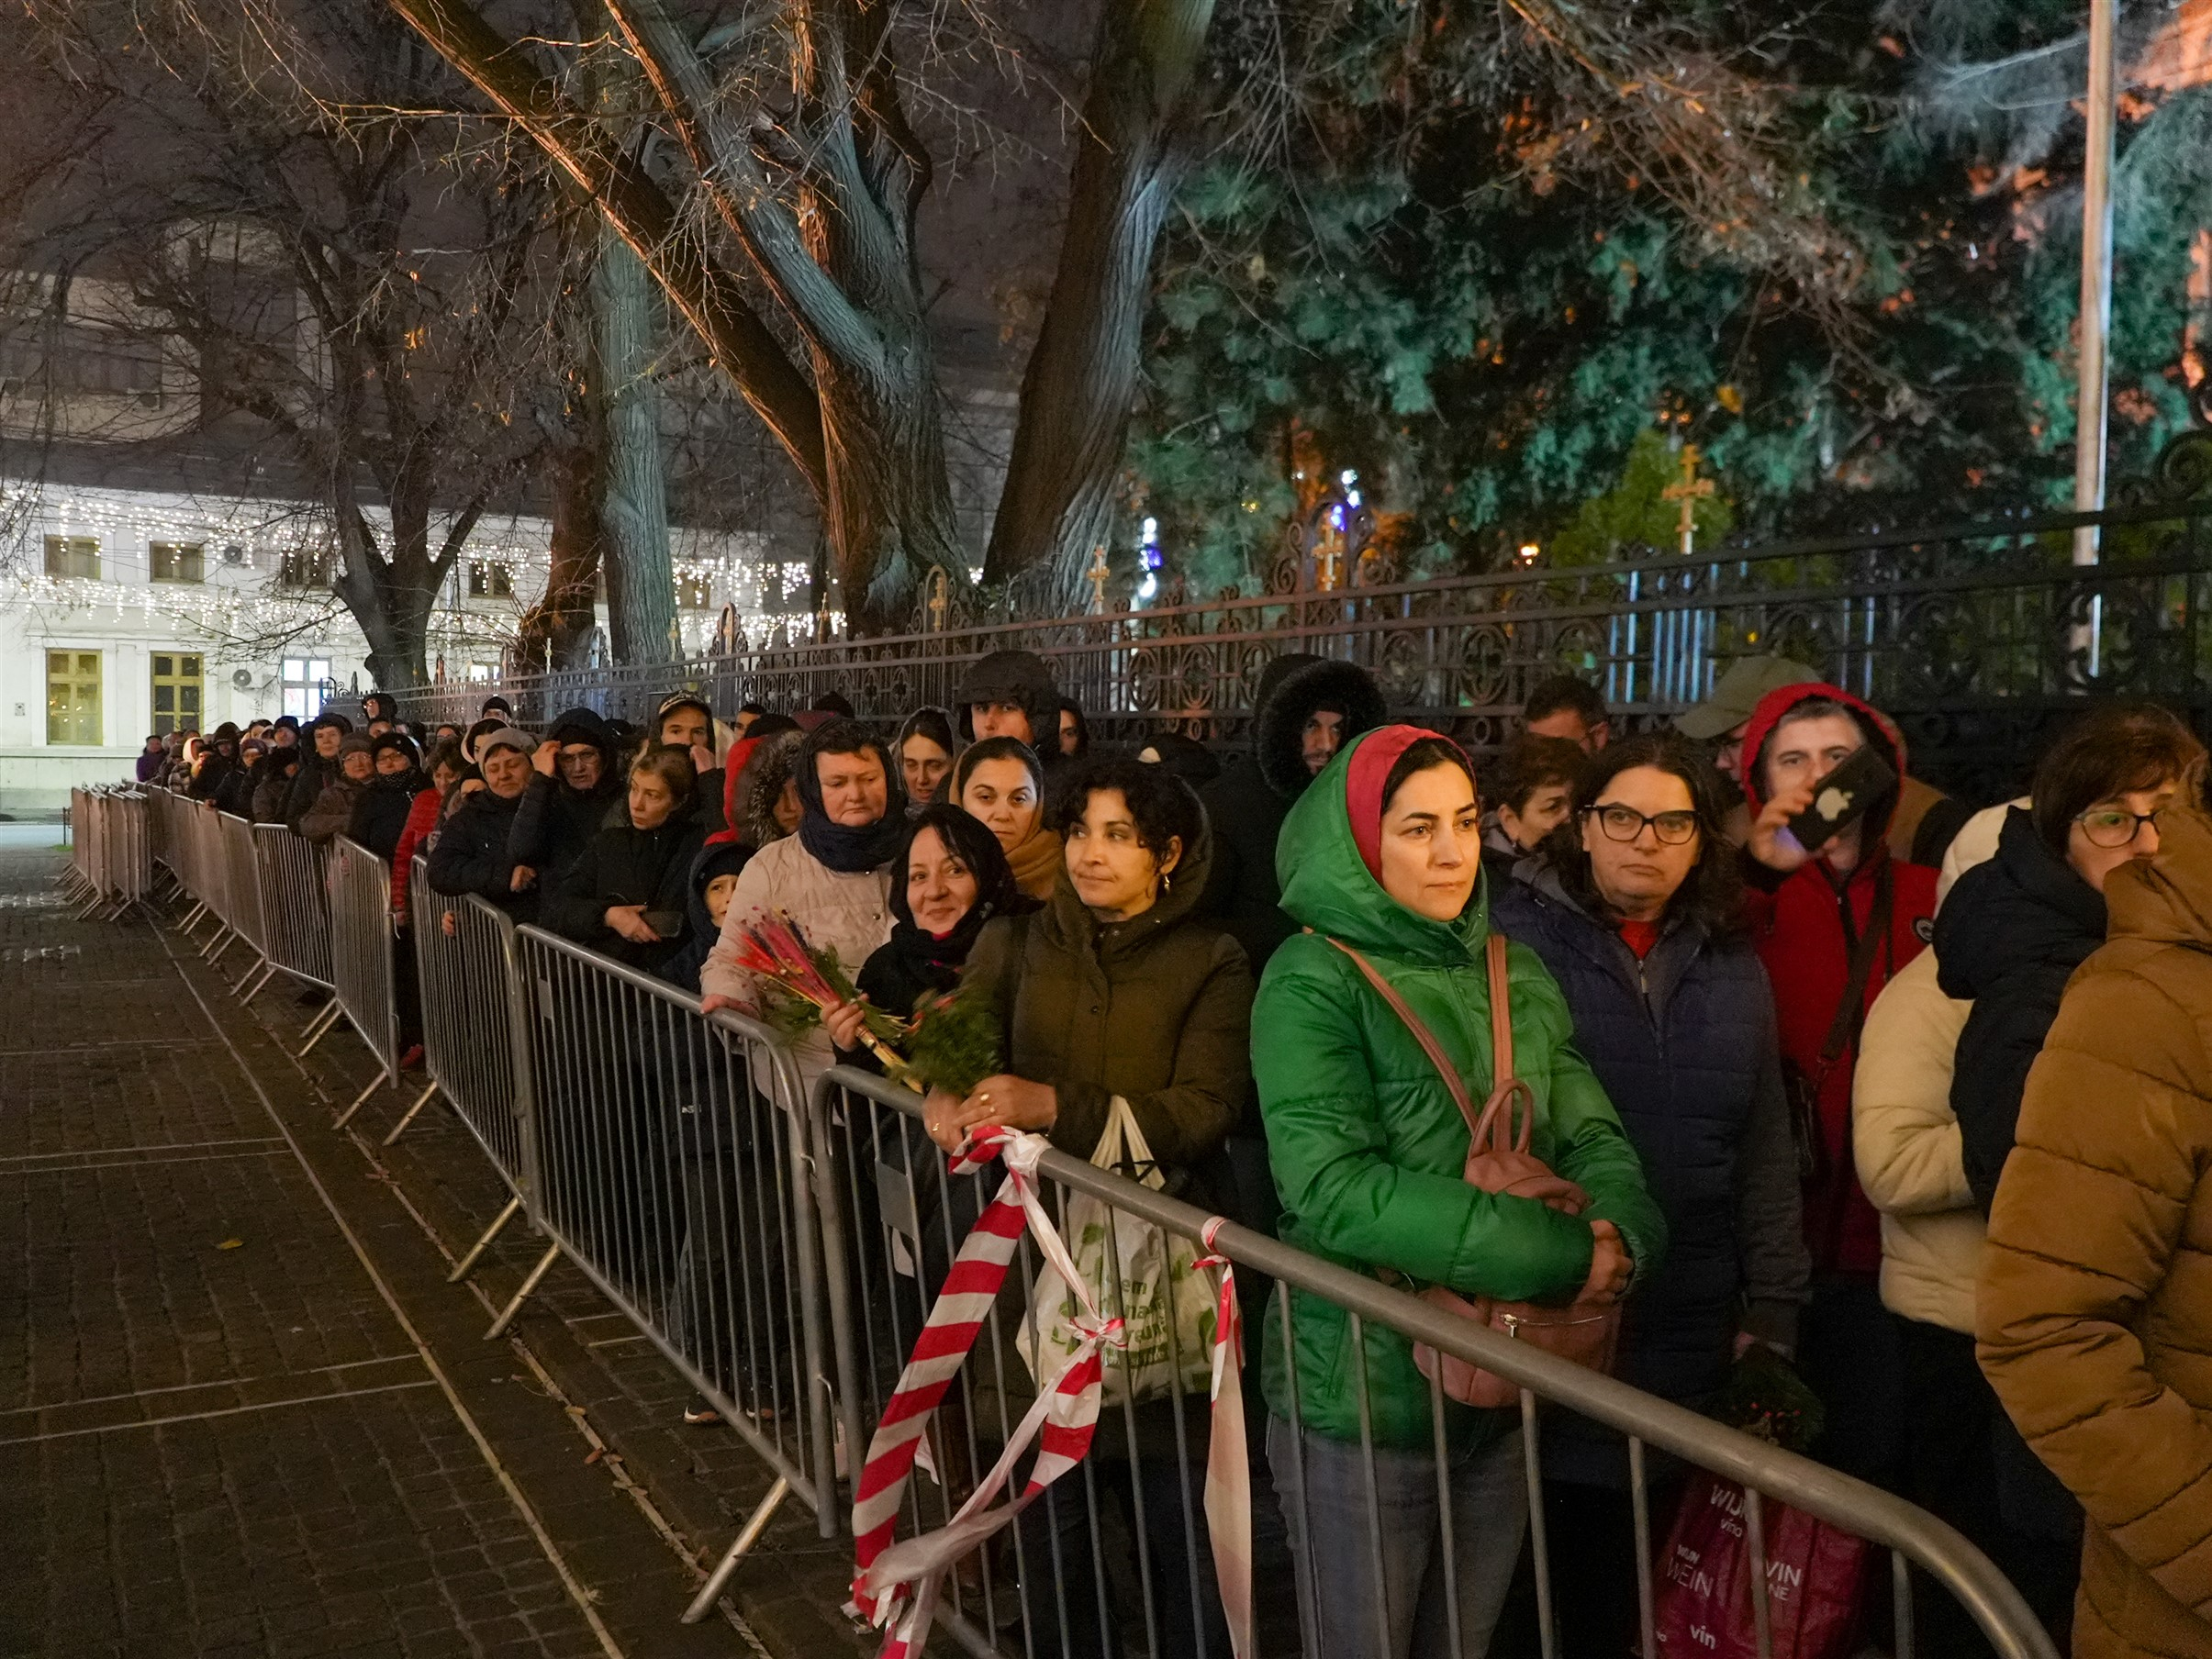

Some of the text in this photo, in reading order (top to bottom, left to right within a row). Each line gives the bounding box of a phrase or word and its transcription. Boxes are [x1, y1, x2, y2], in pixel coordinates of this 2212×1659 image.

[1666, 1557, 1714, 1598] WEIN
[1766, 1560, 1802, 1587] VIN
[1690, 1623, 1715, 1651] vin
